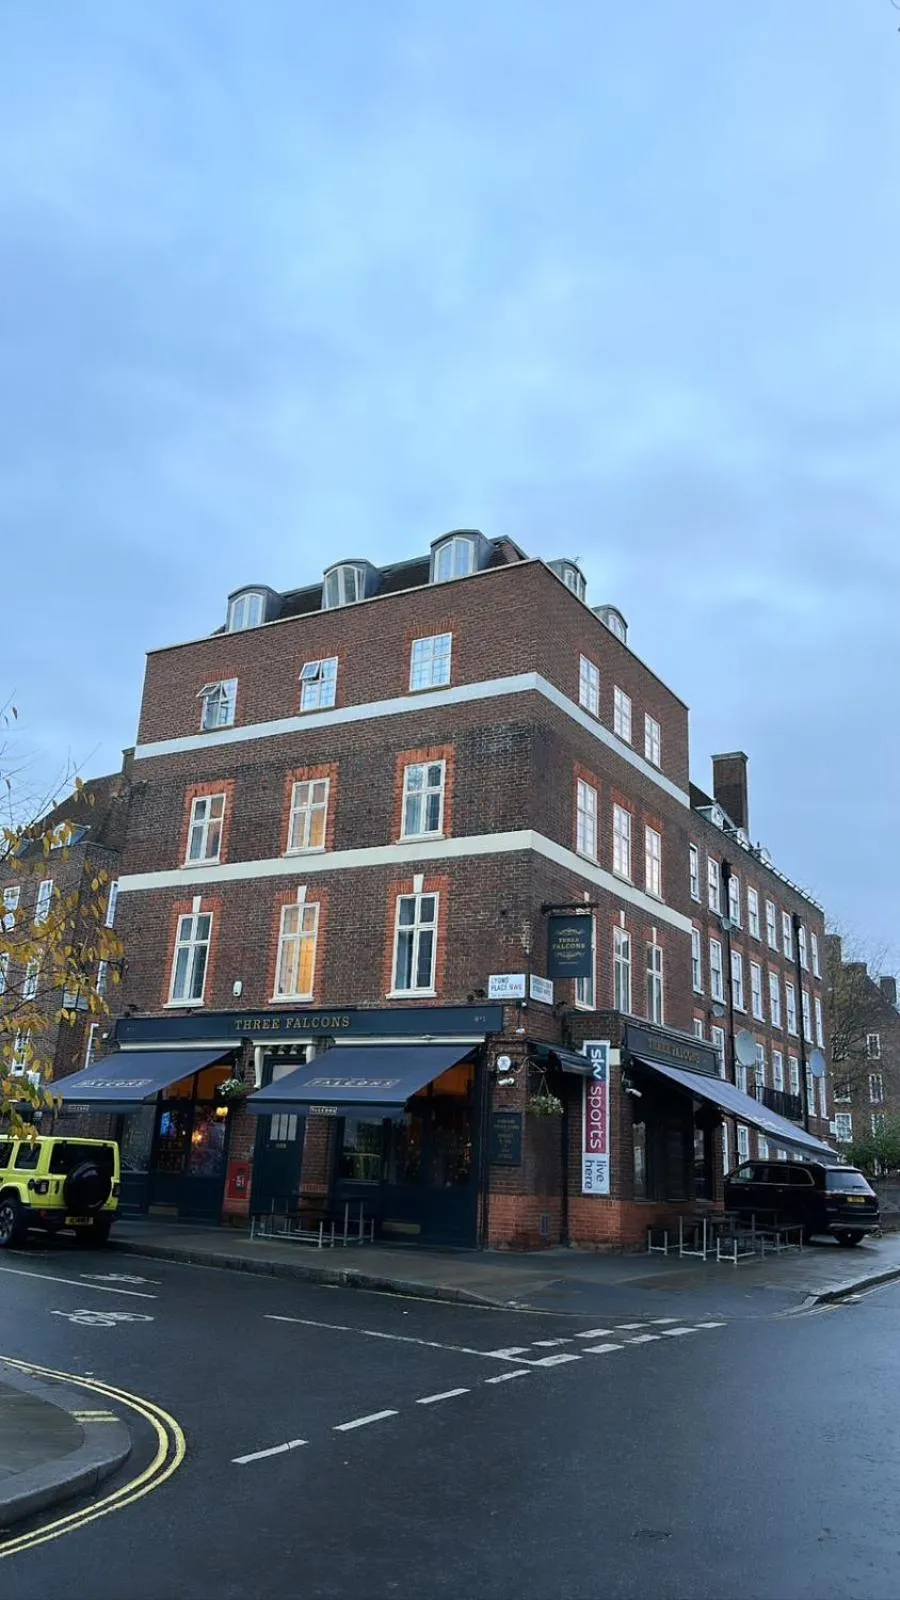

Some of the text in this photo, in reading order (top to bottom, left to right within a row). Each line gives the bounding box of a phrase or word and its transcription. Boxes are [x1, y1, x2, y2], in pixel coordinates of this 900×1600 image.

[235, 1016, 350, 1031] THREE FALCONS
[591, 1048, 605, 1079] sky
[588, 1086, 603, 1149] sports
[584, 1160, 595, 1190] here
[596, 1160, 607, 1183] live
